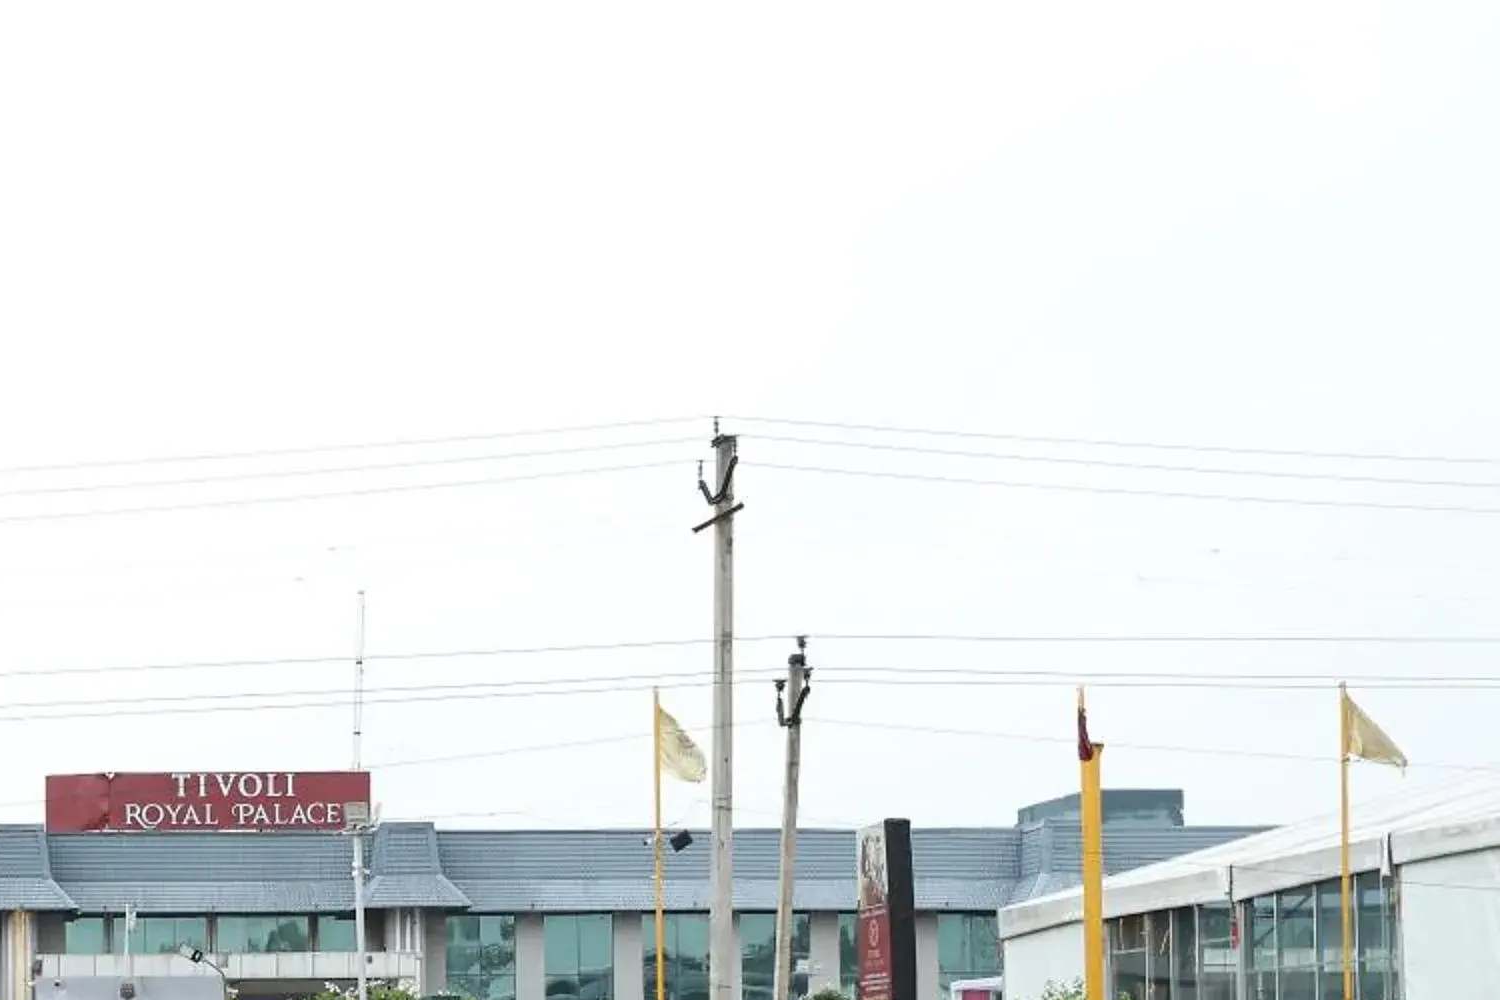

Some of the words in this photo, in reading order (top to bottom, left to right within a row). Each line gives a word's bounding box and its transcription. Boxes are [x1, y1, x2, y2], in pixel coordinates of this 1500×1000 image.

[171, 773, 296, 798] TIVOLI
[125, 803, 219, 828] ROYAL
[231, 802, 341, 825] PALACE
